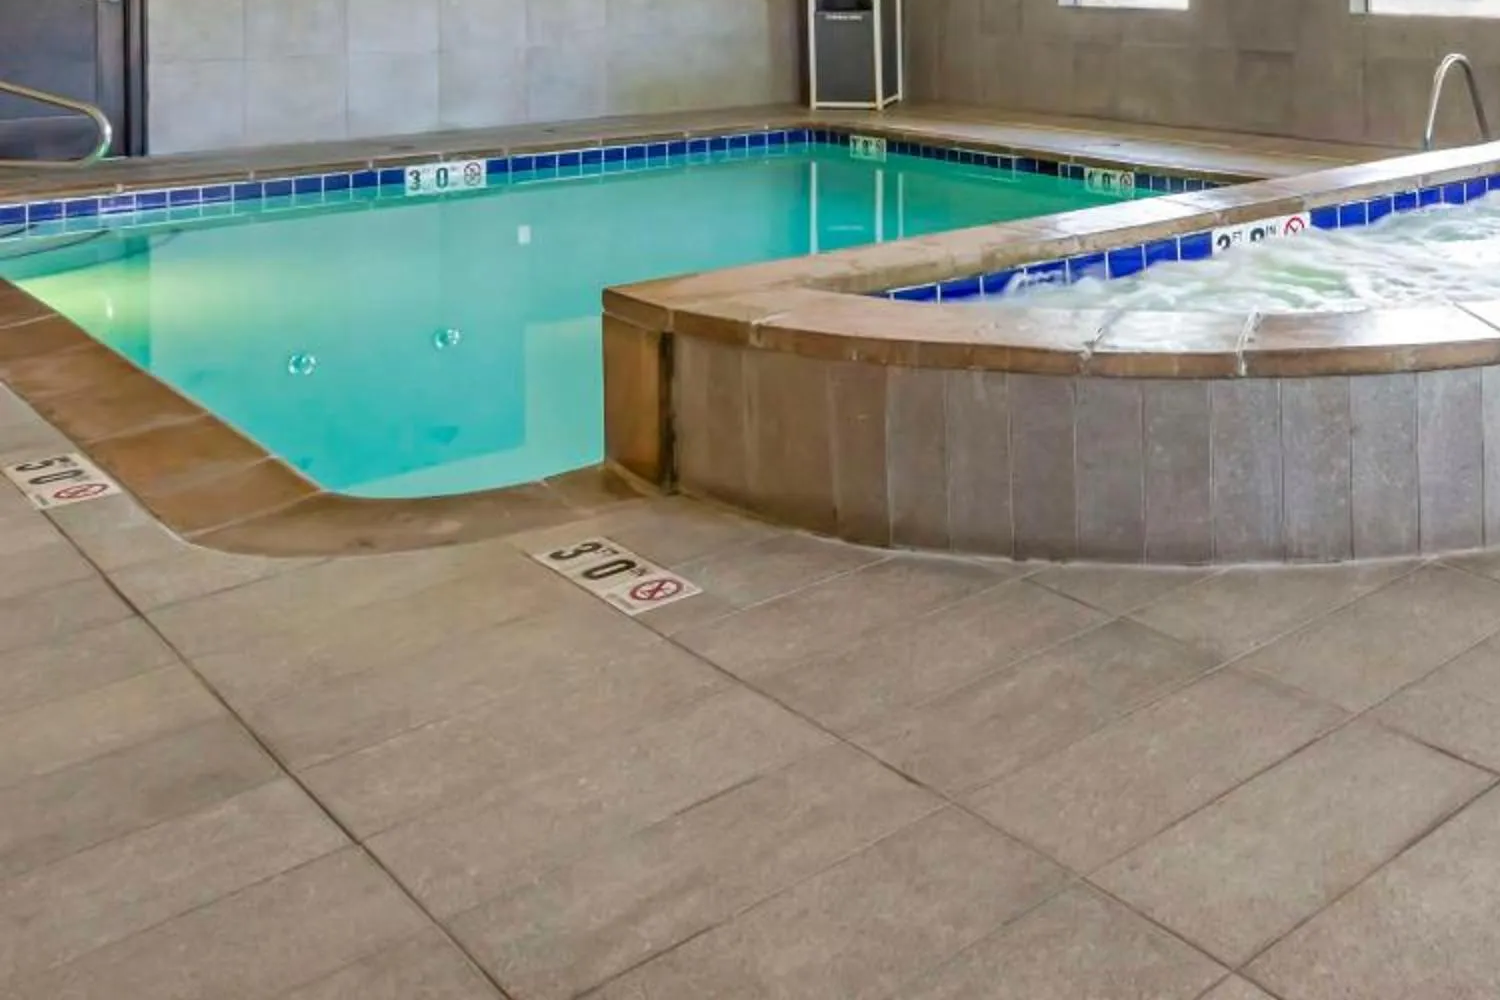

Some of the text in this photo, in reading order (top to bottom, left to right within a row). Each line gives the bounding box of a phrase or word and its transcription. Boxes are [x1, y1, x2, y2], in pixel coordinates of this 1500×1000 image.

[28, 469, 84, 485] 0
[549, 541, 602, 560] 3
[582, 559, 637, 580] 0
